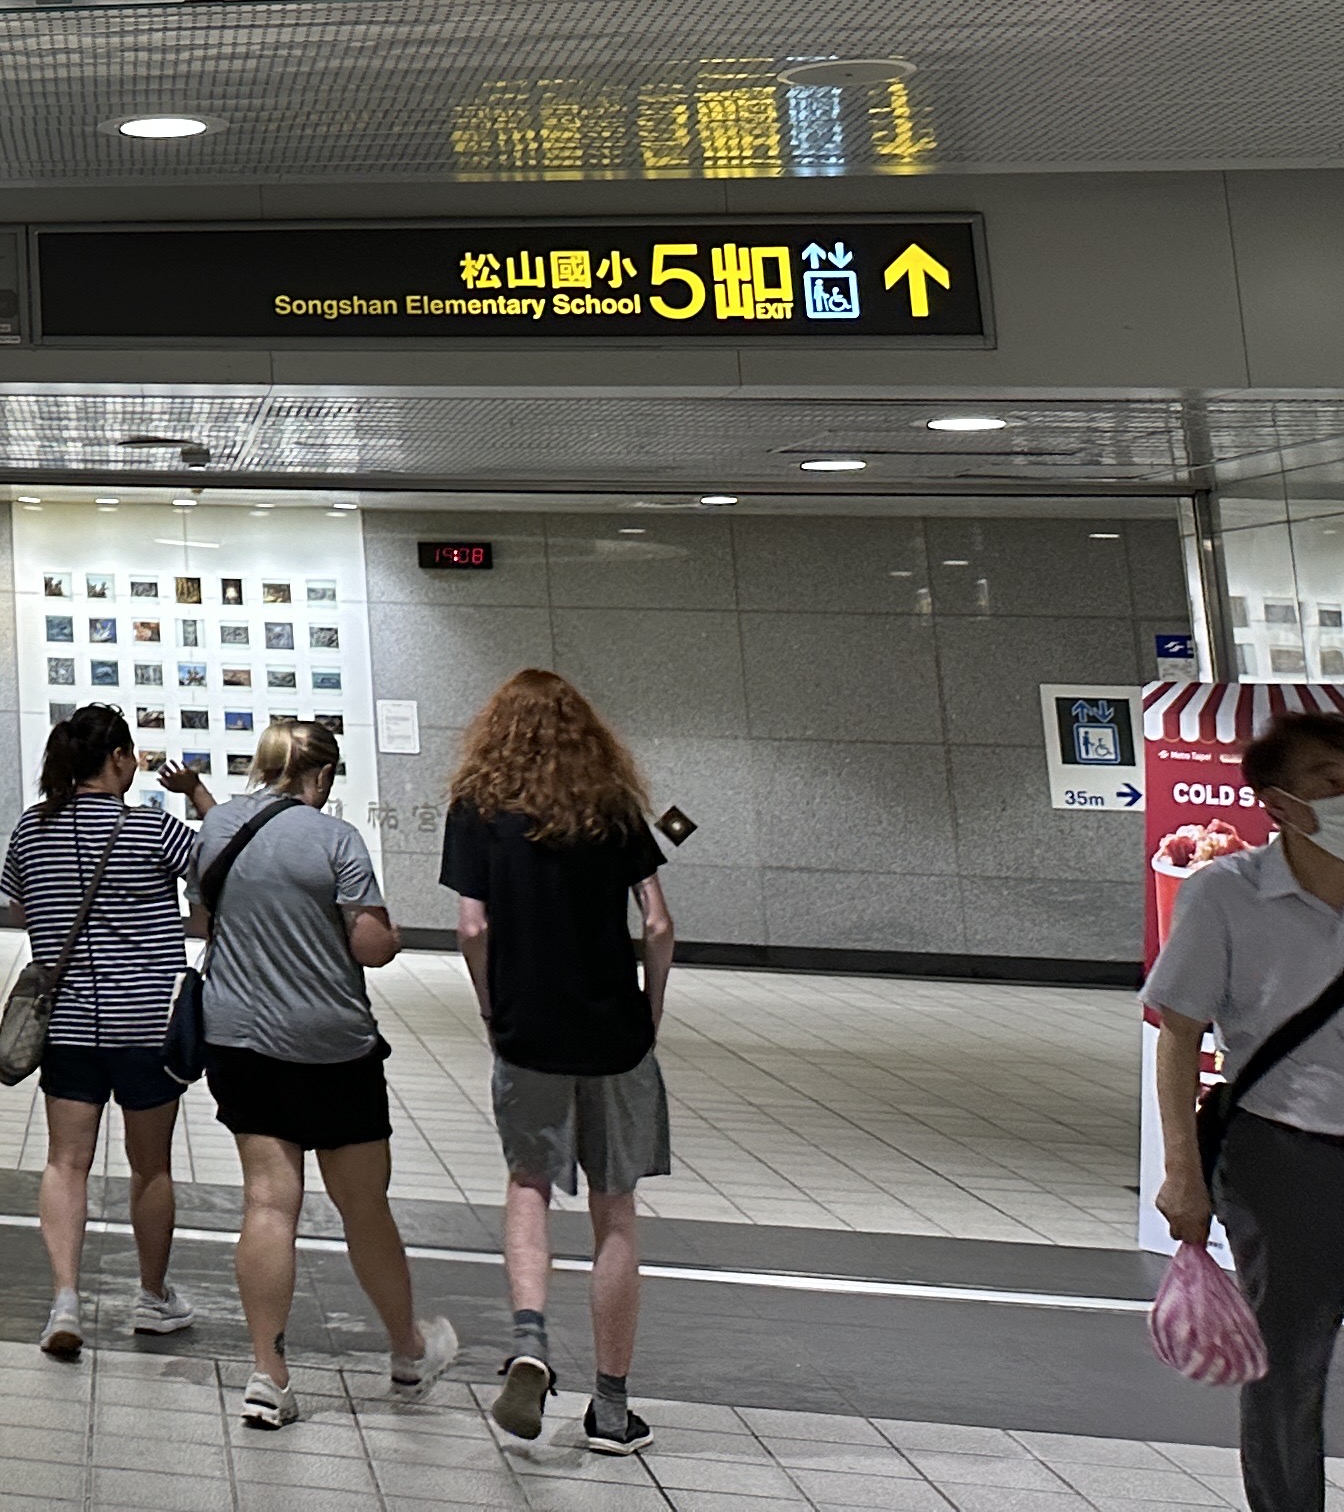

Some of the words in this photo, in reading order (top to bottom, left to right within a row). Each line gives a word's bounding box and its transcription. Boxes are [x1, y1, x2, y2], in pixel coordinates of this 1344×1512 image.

[460, 250, 637, 289] 松山國小
[275, 295, 398, 319] Songshan
[406, 294, 545, 319] Elementary
[553, 293, 641, 315] School
[756, 302, 793, 319] EXIT
[435, 548, 484, 565] 19:08
[1064, 790, 1105, 806] 35m
[1173, 782, 1235, 807] COLD
